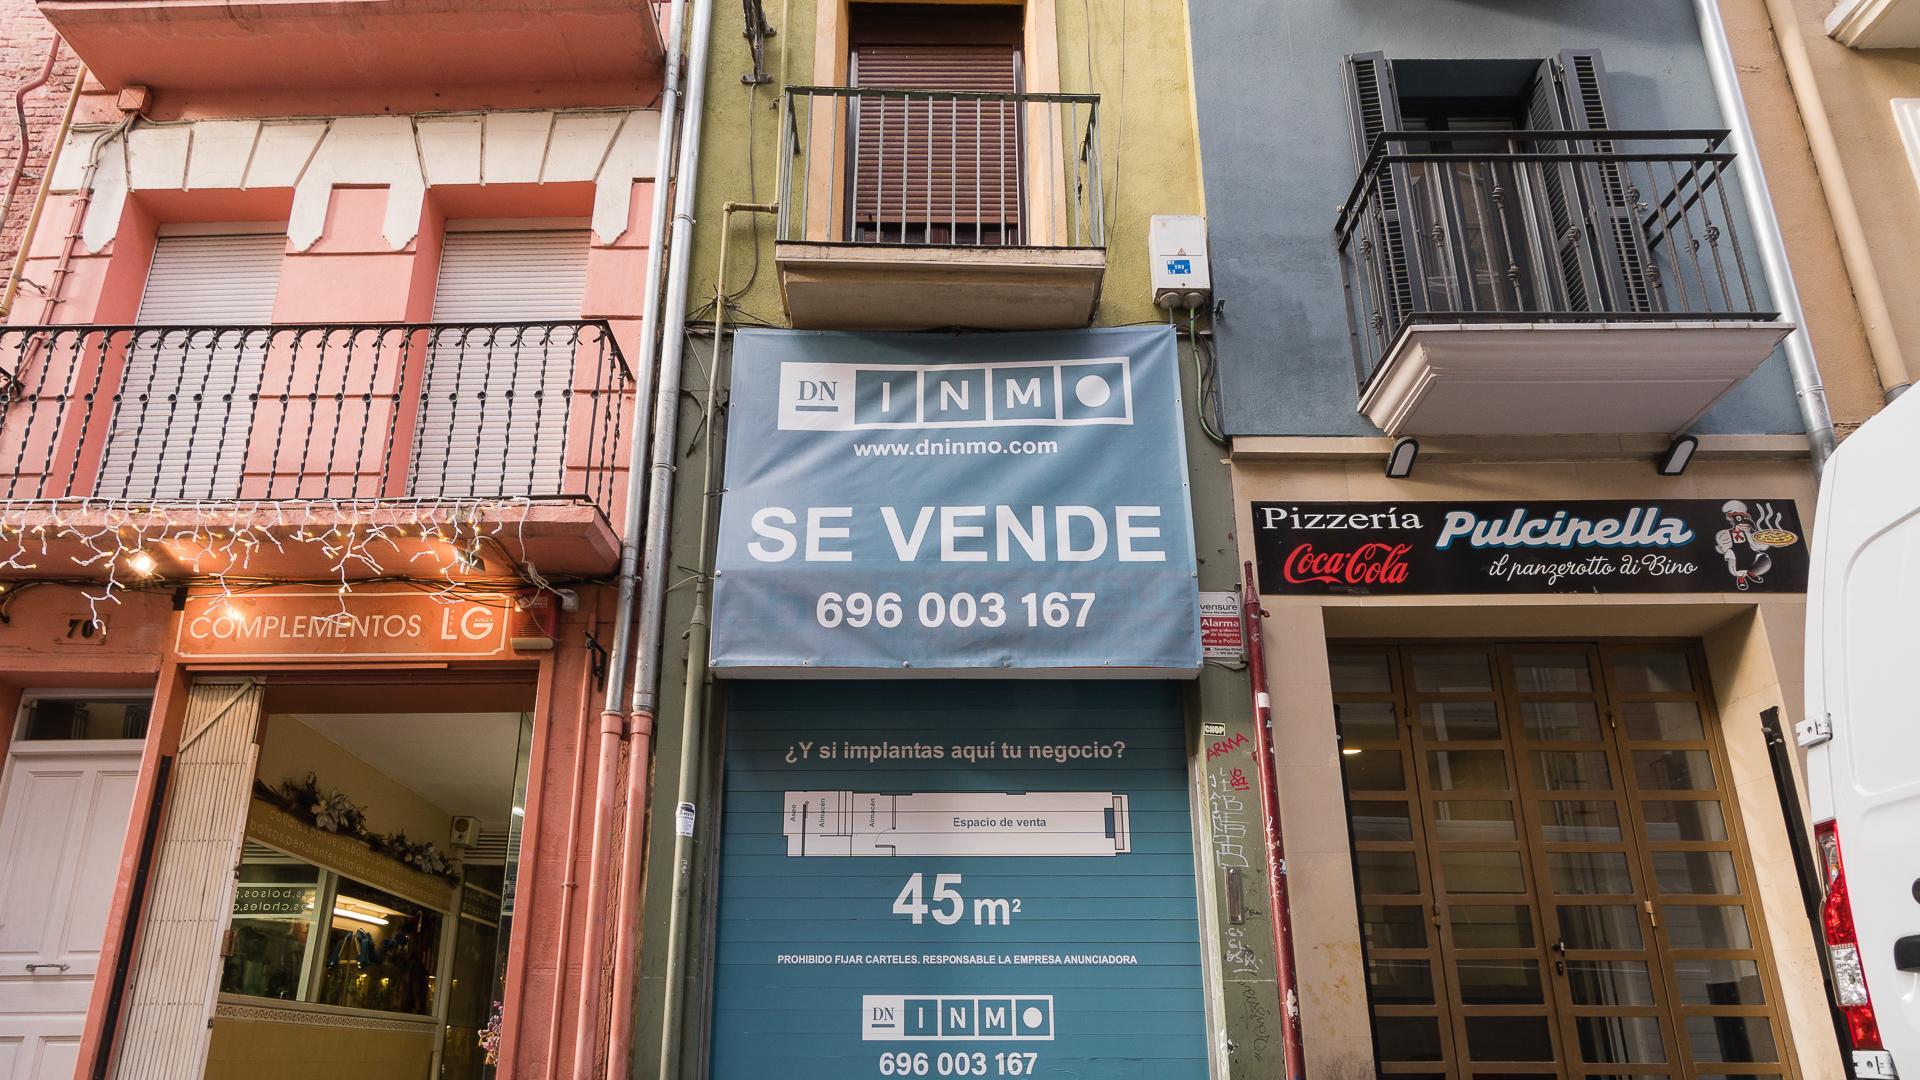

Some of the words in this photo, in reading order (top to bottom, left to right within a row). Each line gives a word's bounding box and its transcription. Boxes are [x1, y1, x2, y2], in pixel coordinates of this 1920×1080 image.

[797, 380, 839, 401] DN
[853, 438, 1059, 458] www.dninmo.com
[1260, 506, 1424, 530] Pizzería
[1435, 507, 1696, 550] Pulcinella
[747, 506, 853, 563] SE
[880, 505, 1166, 562] VENDE
[1283, 543, 1415, 585] Coca-Cola
[1489, 554, 1510, 576] il
[1506, 555, 1616, 586] panzerotto
[1620, 554, 1641, 575] di
[1641, 554, 1699, 576] Bino
[816, 591, 903, 628] 696
[918, 591, 1007, 628] 003
[1021, 591, 1096, 628] 167
[1200, 603, 1238, 611] verisure
[66, 618, 95, 640] 70
[189, 613, 422, 640] COMPLEMENTOS
[1201, 618, 1240, 627] Alarma
[785, 741, 814, 763] ¿Y
[818, 741, 837, 759] si
[844, 741, 945, 763] implantas
[951, 741, 995, 763] aquí
[1001, 742, 1022, 759] tu
[1028, 741, 1126, 763] negocio?
[1206, 732, 1249, 762] ARMA
[952, 817, 999, 829] Espacio
[1003, 817, 1014, 828] de
[1015, 818, 1047, 828] venta
[891, 872, 966, 925] 45
[777, 954, 833, 965] PROHIBIDO
[834, 954, 863, 965] FIJAR
[865, 954, 920, 965] CARTELES.
[922, 954, 996, 965] RESPONSABLE
[998, 954, 1011, 965] LA
[1013, 954, 1062, 965] EMPRESA
[1063, 954, 1138, 965] ANUNCIADORA
[872, 1006, 895, 1021] DN
[879, 1052, 929, 1076] 696
[937, 1052, 987, 1076] 003
[994, 1052, 1038, 1076] 167
